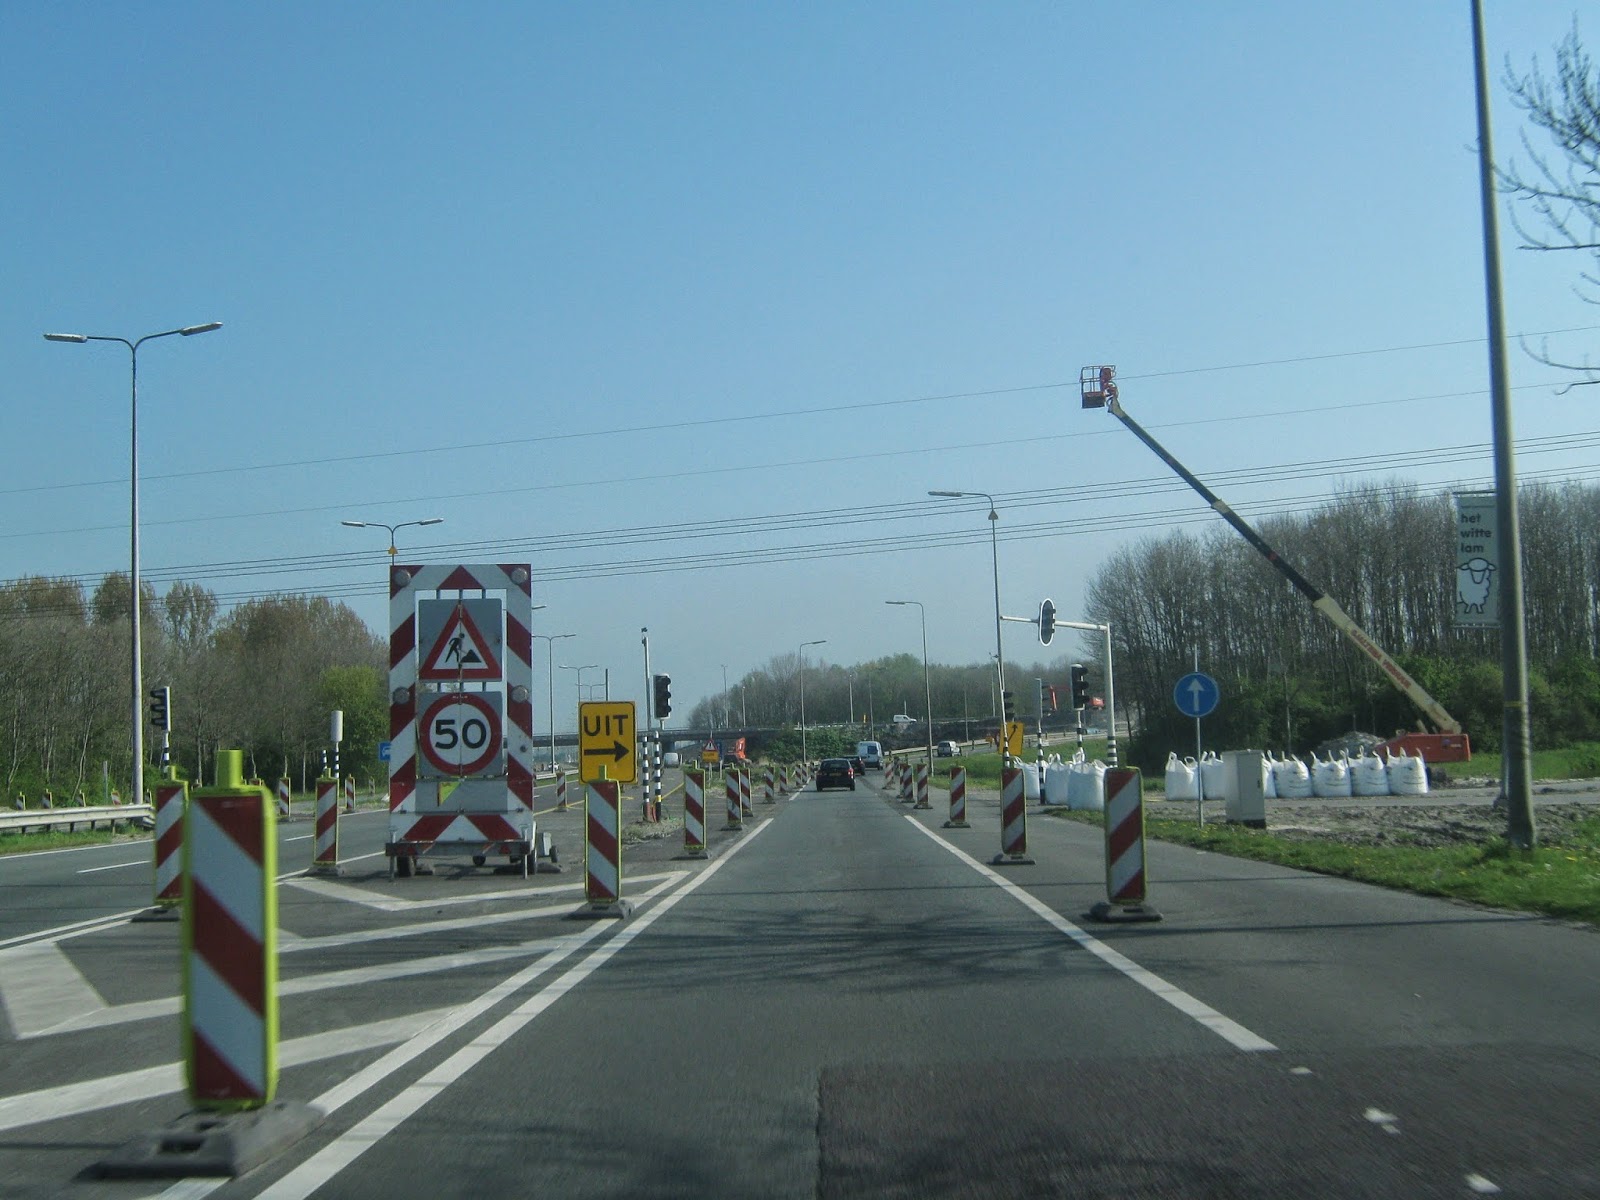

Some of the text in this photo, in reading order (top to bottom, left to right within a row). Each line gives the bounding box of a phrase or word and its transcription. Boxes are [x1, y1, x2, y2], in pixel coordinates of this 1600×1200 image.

[1460, 513, 1482, 523] het
[1460, 528, 1492, 538] witte
[1460, 543, 1484, 553] lam
[583, 714, 629, 737] UIT
[435, 718, 487, 750] 50
